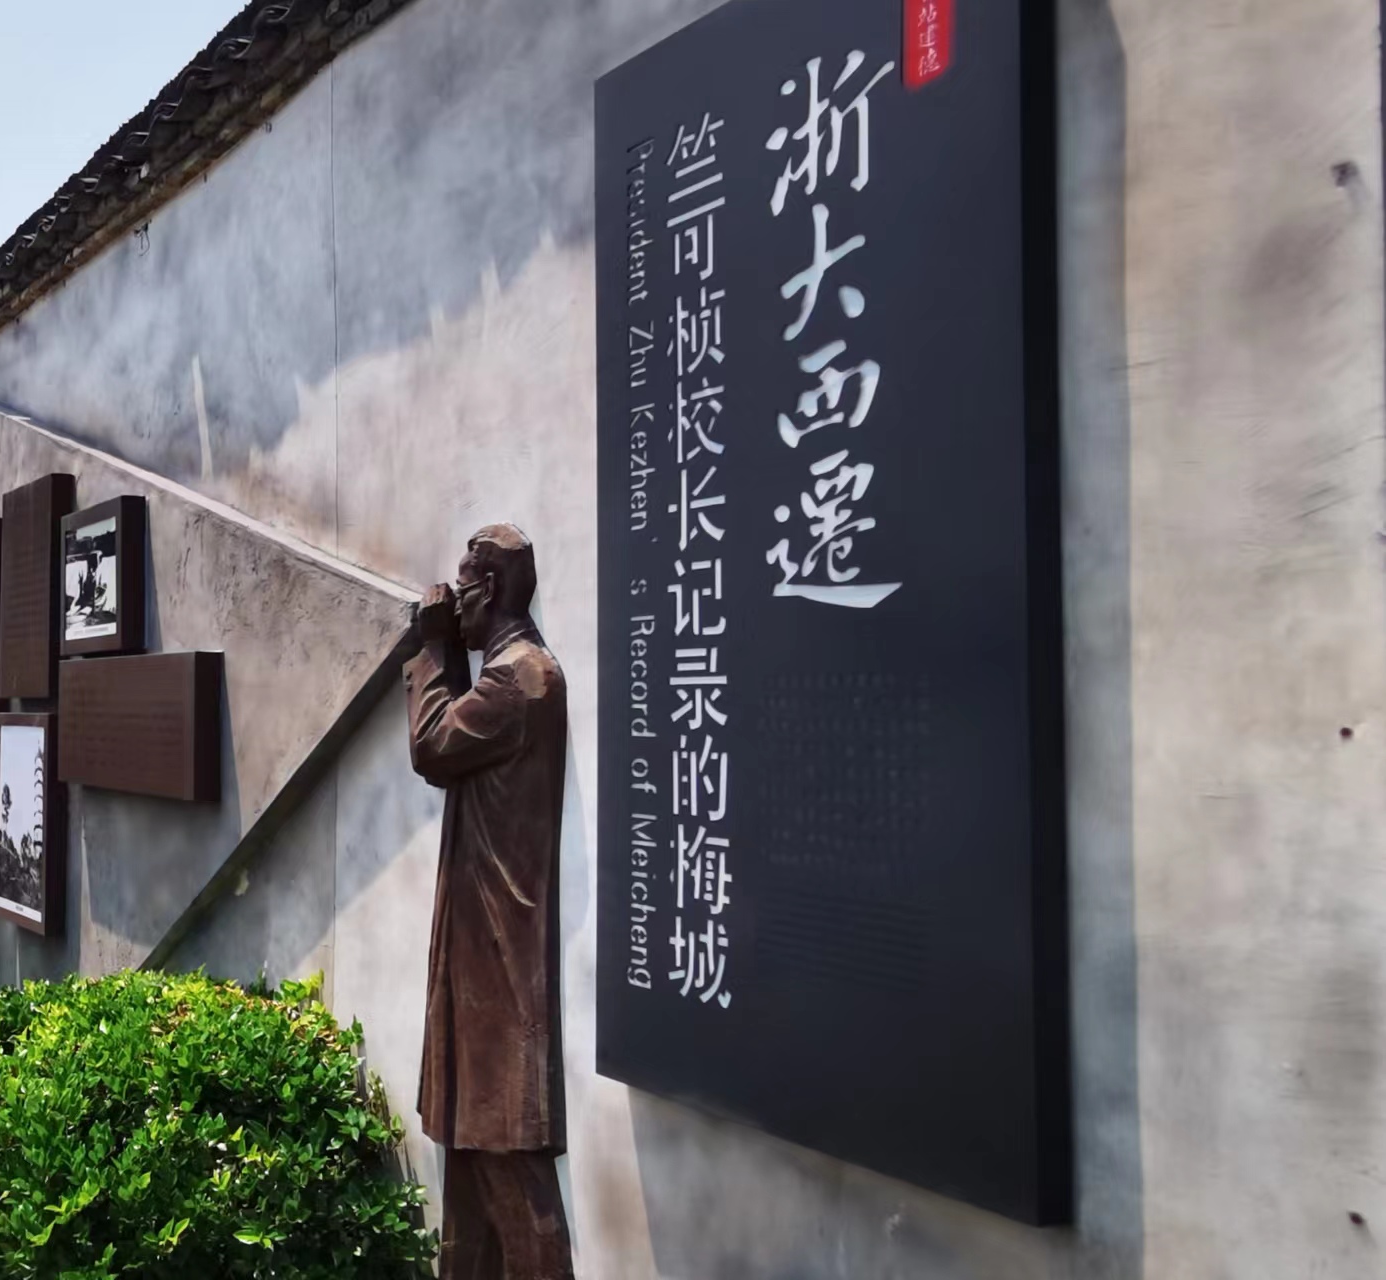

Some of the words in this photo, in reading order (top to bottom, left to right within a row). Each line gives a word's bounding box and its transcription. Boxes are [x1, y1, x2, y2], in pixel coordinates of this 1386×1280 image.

[627, 137, 655, 307] President
[629, 320, 655, 388] Zhu
[666, 112, 733, 1009] 竺可桢校长记录的梅城
[630, 614, 657, 738] Record
[630, 757, 658, 795] of
[626, 812, 658, 990] Meicheng
